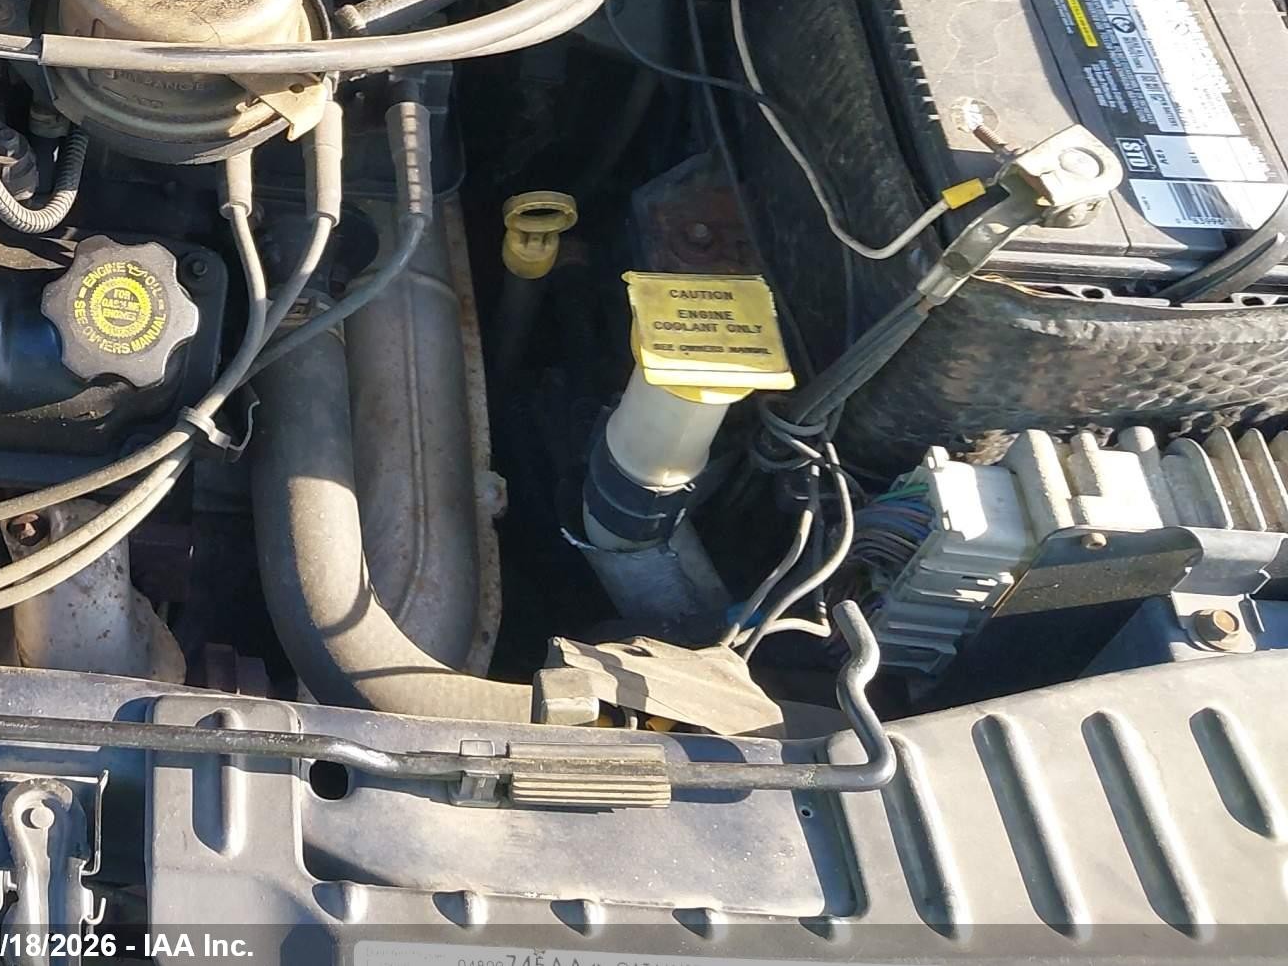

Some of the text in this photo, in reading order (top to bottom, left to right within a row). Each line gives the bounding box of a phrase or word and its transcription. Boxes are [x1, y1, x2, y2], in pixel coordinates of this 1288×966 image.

[1120, 138, 1149, 171] STD
[83, 262, 164, 298] ENGINE OIL
[669, 289, 734, 300] CAUTION
[73, 301, 89, 326] SEE
[131, 313, 167, 352] MANUAL
[678, 310, 734, 321] ENGINE
[653, 321, 763, 334] COOLANT ONLY
